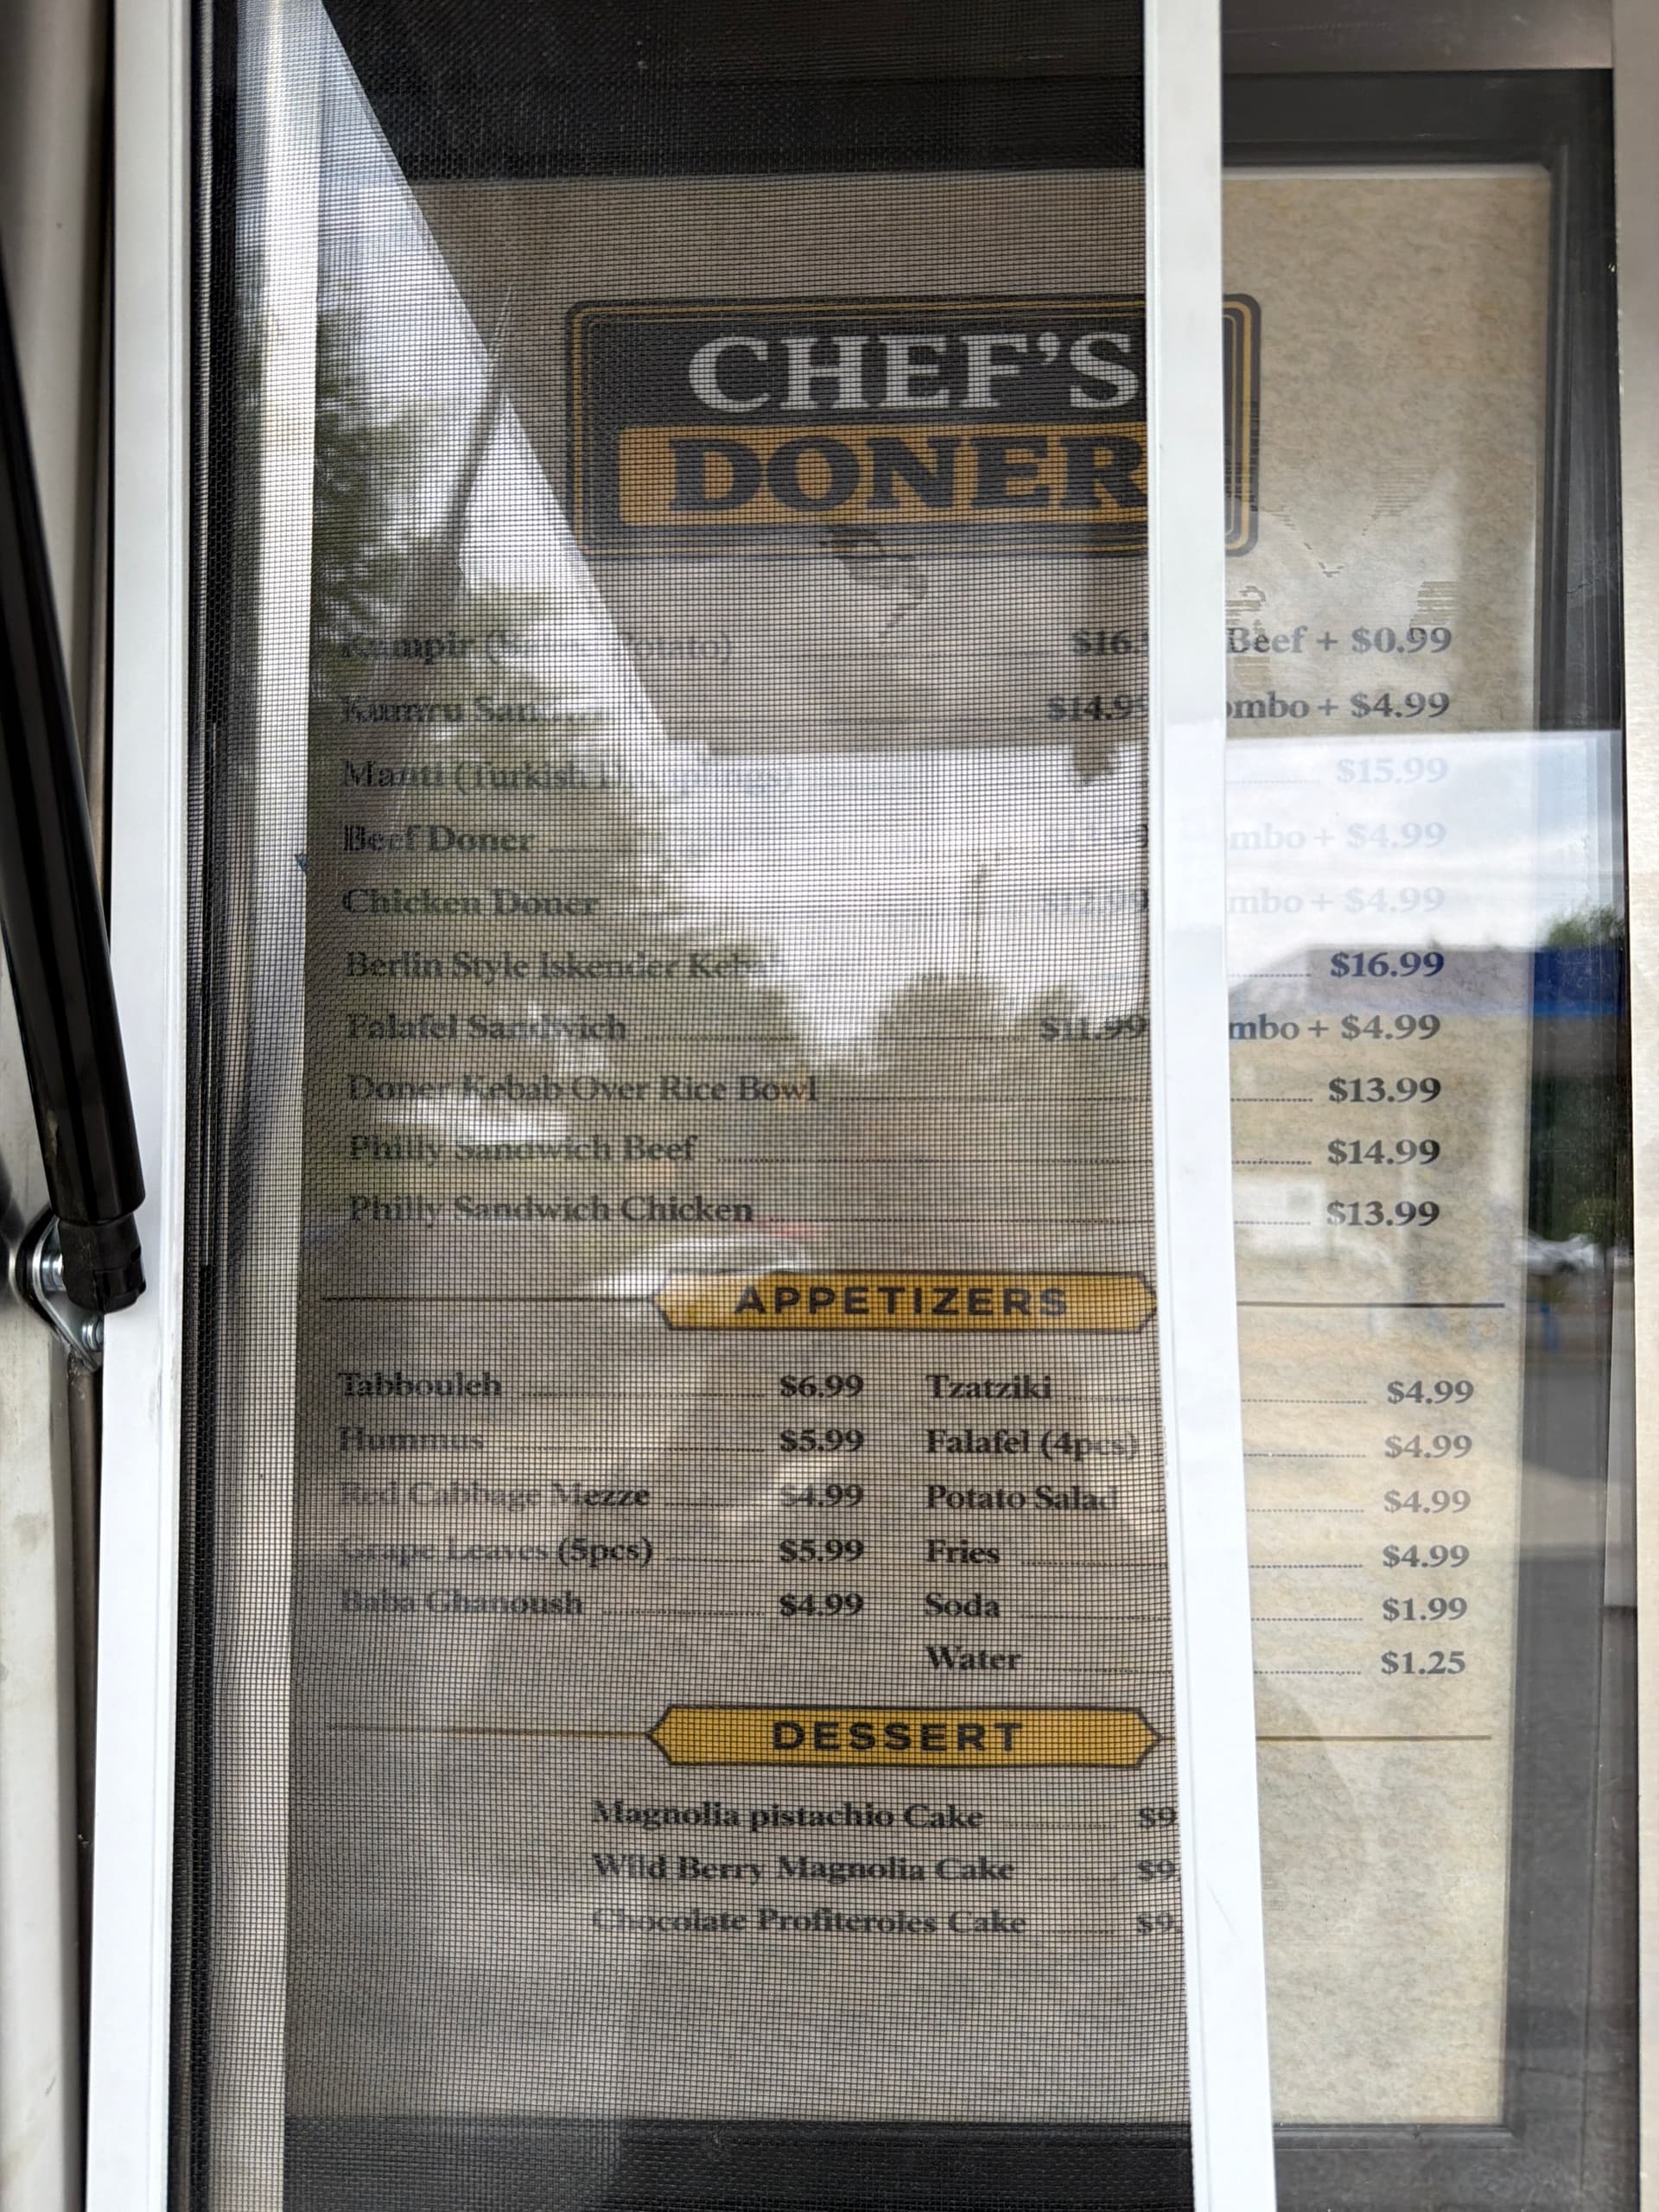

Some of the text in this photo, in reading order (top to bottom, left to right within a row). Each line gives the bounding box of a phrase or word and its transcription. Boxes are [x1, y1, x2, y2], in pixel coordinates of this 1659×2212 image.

[690, 332, 1141, 412] CHEF'S
[670, 435, 1146, 512] DONER
[1071, 627, 1147, 657] $16.
[1227, 626, 1307, 654] Beef
[1351, 627, 1452, 653] $0.99
[1351, 692, 1451, 719] $4.99
[1335, 757, 1448, 785] $15.99
[343, 824, 422, 854] Beef
[428, 824, 536, 853] Doner
[1347, 823, 1446, 850] $4.99
[341, 887, 481, 916] Chicken
[492, 887, 601, 916] Doner
[1344, 887, 1446, 914] $4.99
[346, 950, 443, 978] Berlin
[450, 950, 530, 987] Style
[539, 950, 679, 979] Iskender
[1330, 951, 1445, 978] $16.99
[346, 1012, 458, 1039] Falafel
[467, 1011, 627, 1039] Sandwich
[1341, 1014, 1441, 1040] $4.99
[346, 1071, 1441, 1103] Doner Kebab Over Rice Bowl $13.99
[349, 1133, 1441, 1168] Philly Sandwich Beef $14.99
[349, 1193, 1440, 1230] Philly Sandwich Chicken $13.99
[735, 1286, 1067, 1316] APPETIZERS
[336, 1371, 1474, 1405] Tabbouleh $6.99 Tzatziki $4.99
[338, 1426, 1472, 1462] Hummus $5.99 Falafel (4pcs) $4.99
[408, 1480, 542, 1512] Cabbage
[550, 1480, 652, 1507] Mezze
[780, 1484, 864, 1508] $4.99
[926, 1484, 1027, 1510] Potato
[1033, 1484, 1119, 1510] Salad
[1383, 1490, 1471, 1514] $4.99
[557, 1536, 654, 1569] (5pcs)
[779, 1539, 864, 1563] $5.99
[926, 1537, 1001, 1564] Fries
[1382, 1544, 1470, 1569] $4.99
[424, 1588, 583, 1616] Ghanoush
[779, 1592, 864, 1617] $4.99
[924, 1592, 1001, 1618] Soda
[1382, 1597, 1467, 1623] $1.99
[925, 1644, 1465, 1675] Water $1.25
[774, 1720, 1022, 1751] DESSERT
[591, 1798, 741, 1832] Magnolia
[749, 1802, 895, 1834] pistachio
[904, 1803, 984, 1829] Cake
[591, 1853, 668, 1880] Wild
[679, 1855, 764, 1885] Berry
[777, 1855, 925, 1886] Magnolia
[935, 1856, 1016, 1881] Cake
[591, 1906, 747, 1934] Chocolate
[757, 1906, 937, 1935] Profiteroles
[948, 1908, 1027, 1935] Cake
